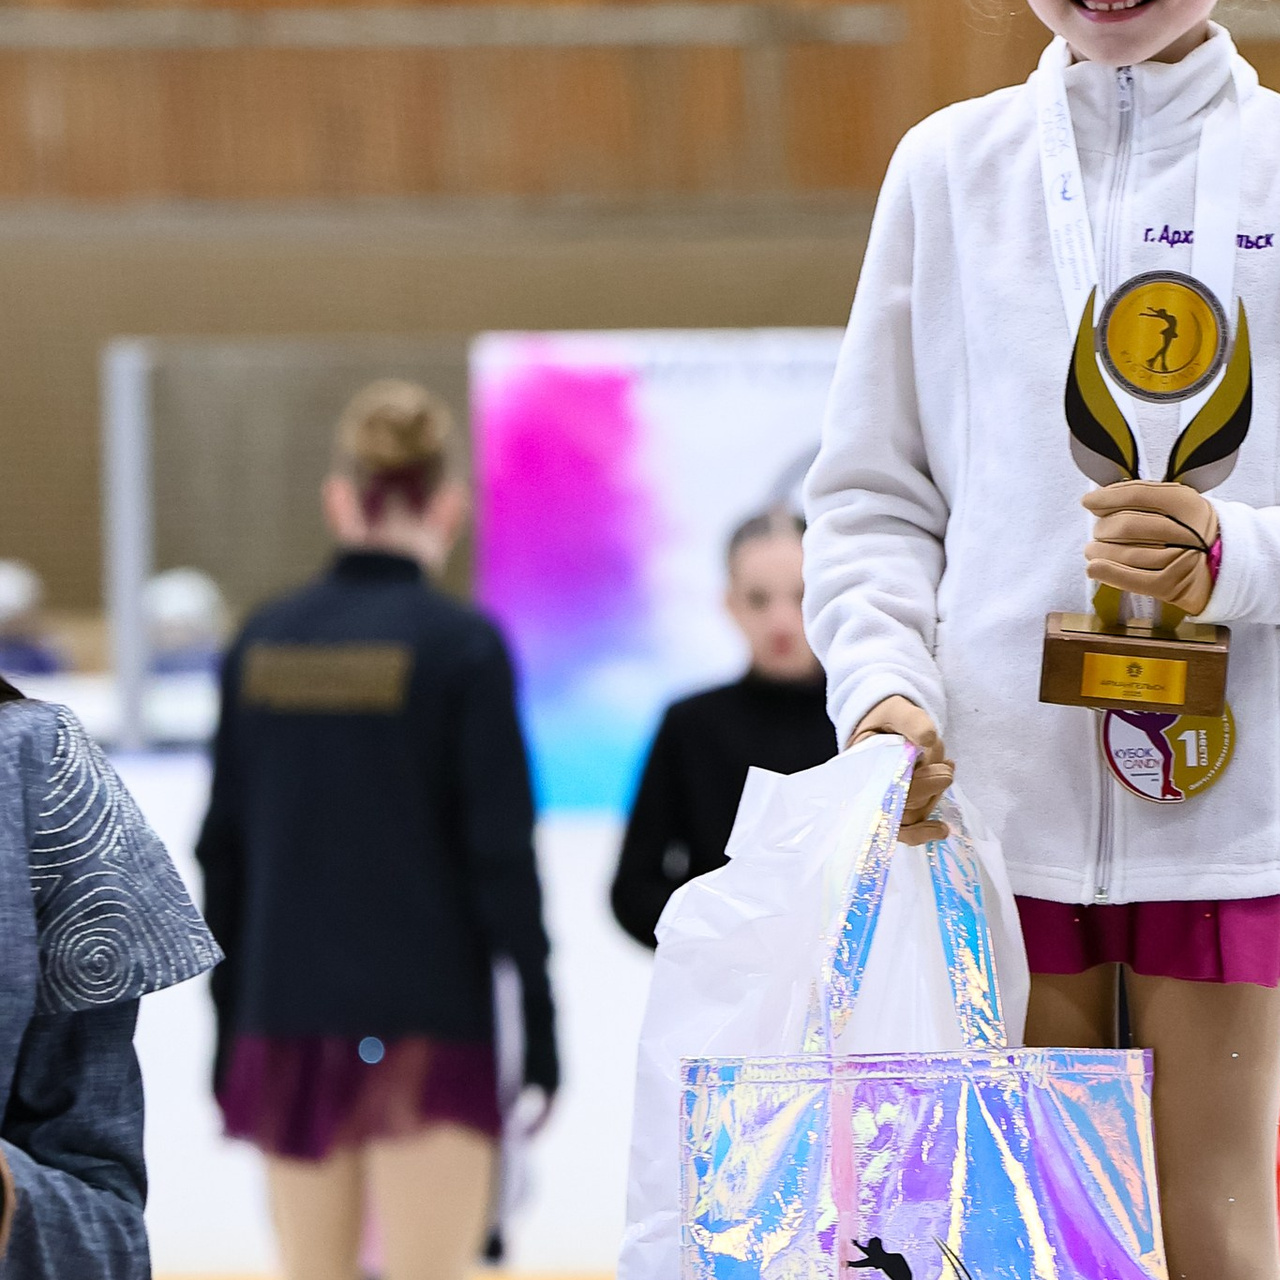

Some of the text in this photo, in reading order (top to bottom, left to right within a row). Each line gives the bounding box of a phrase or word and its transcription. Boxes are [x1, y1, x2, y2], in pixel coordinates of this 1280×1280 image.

[1158, 224, 1275, 249] Архльск
[1114, 747, 1155, 759] КУБОК
[1122, 758, 1161, 770] CANDY
